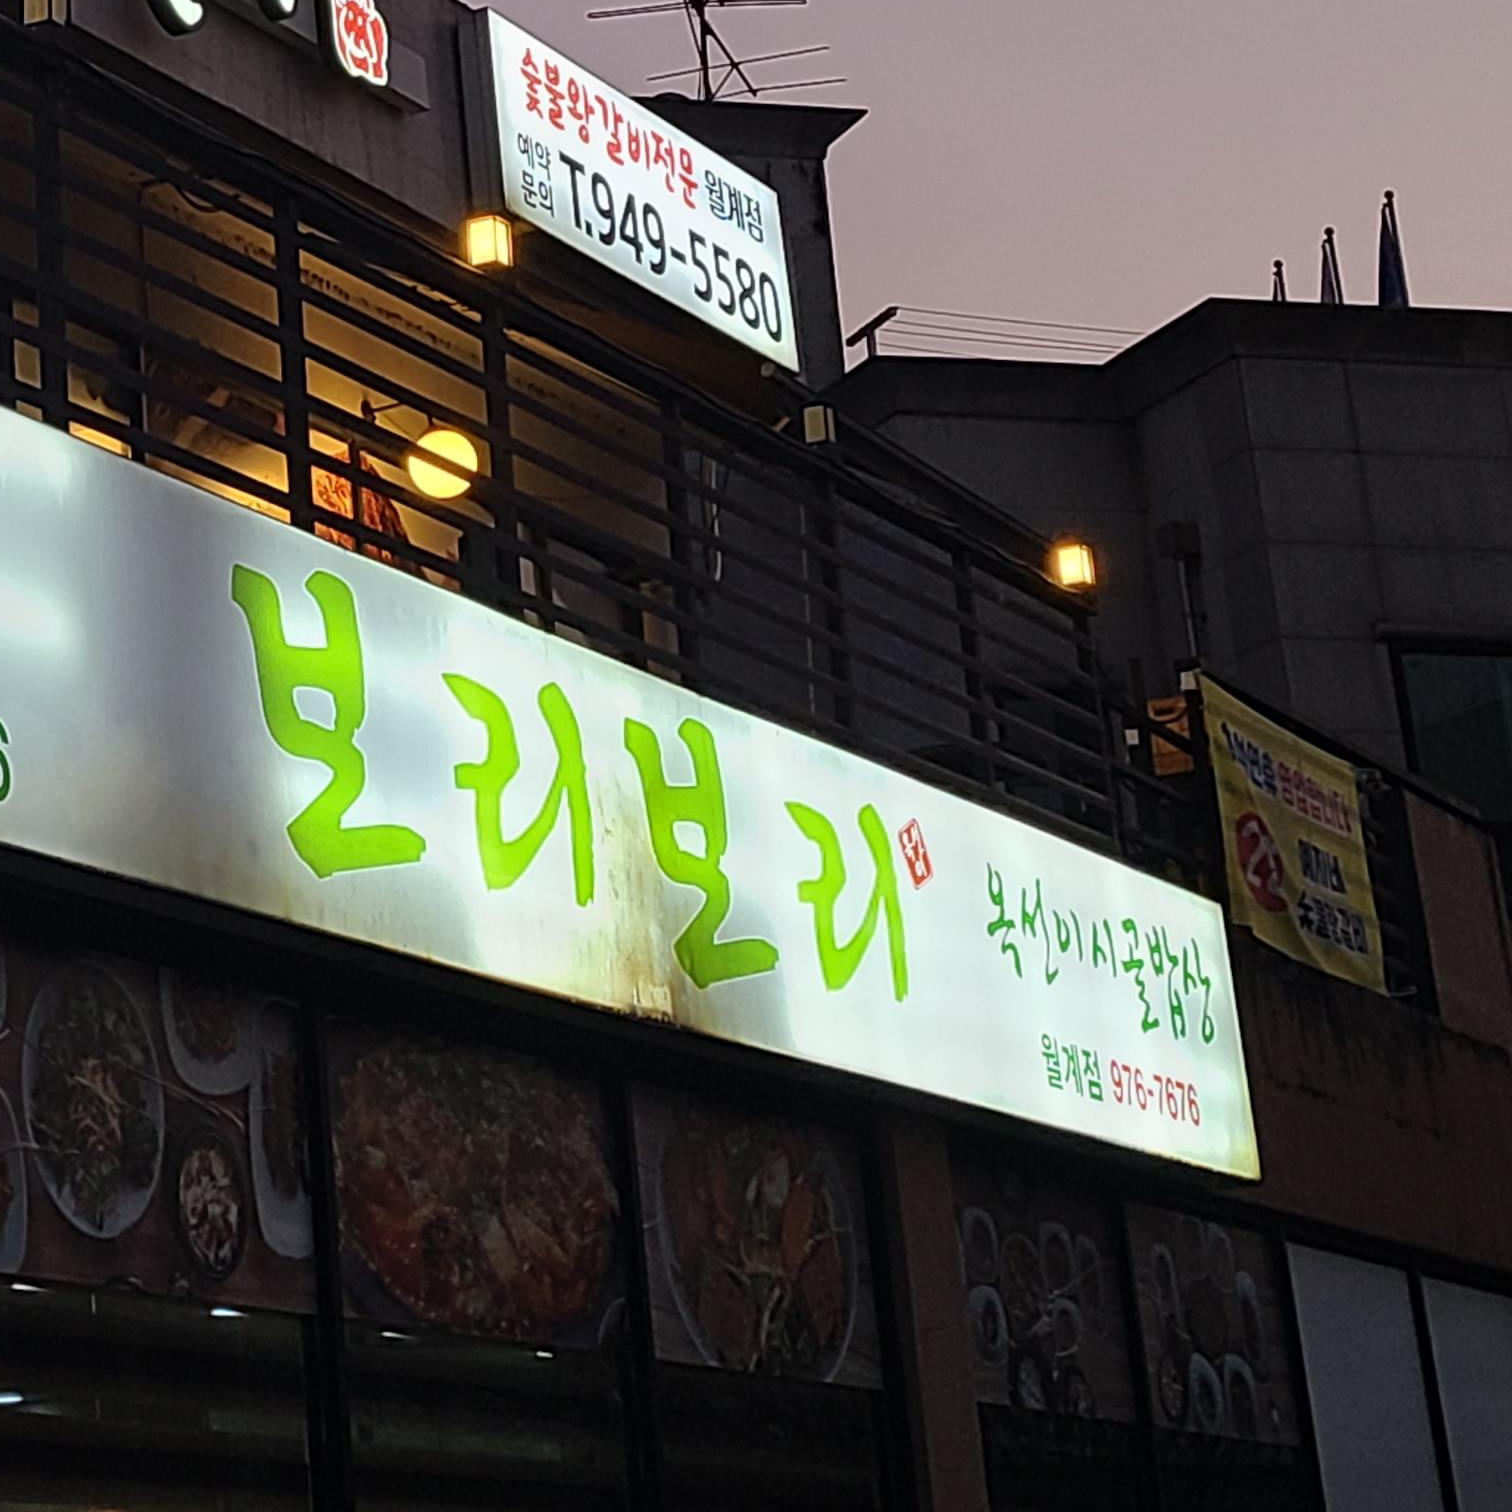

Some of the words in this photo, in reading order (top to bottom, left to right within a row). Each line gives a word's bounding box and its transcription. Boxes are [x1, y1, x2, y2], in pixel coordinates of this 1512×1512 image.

[517, 133, 552, 181] 예약
[520, 170, 555, 218] 문의
[704, 169, 765, 244] 월계점
[559, 150, 782, 344] T.949-5580
[1041, 1033, 1105, 1102] 월계점
[1109, 1058, 1201, 1128] 976-7676
